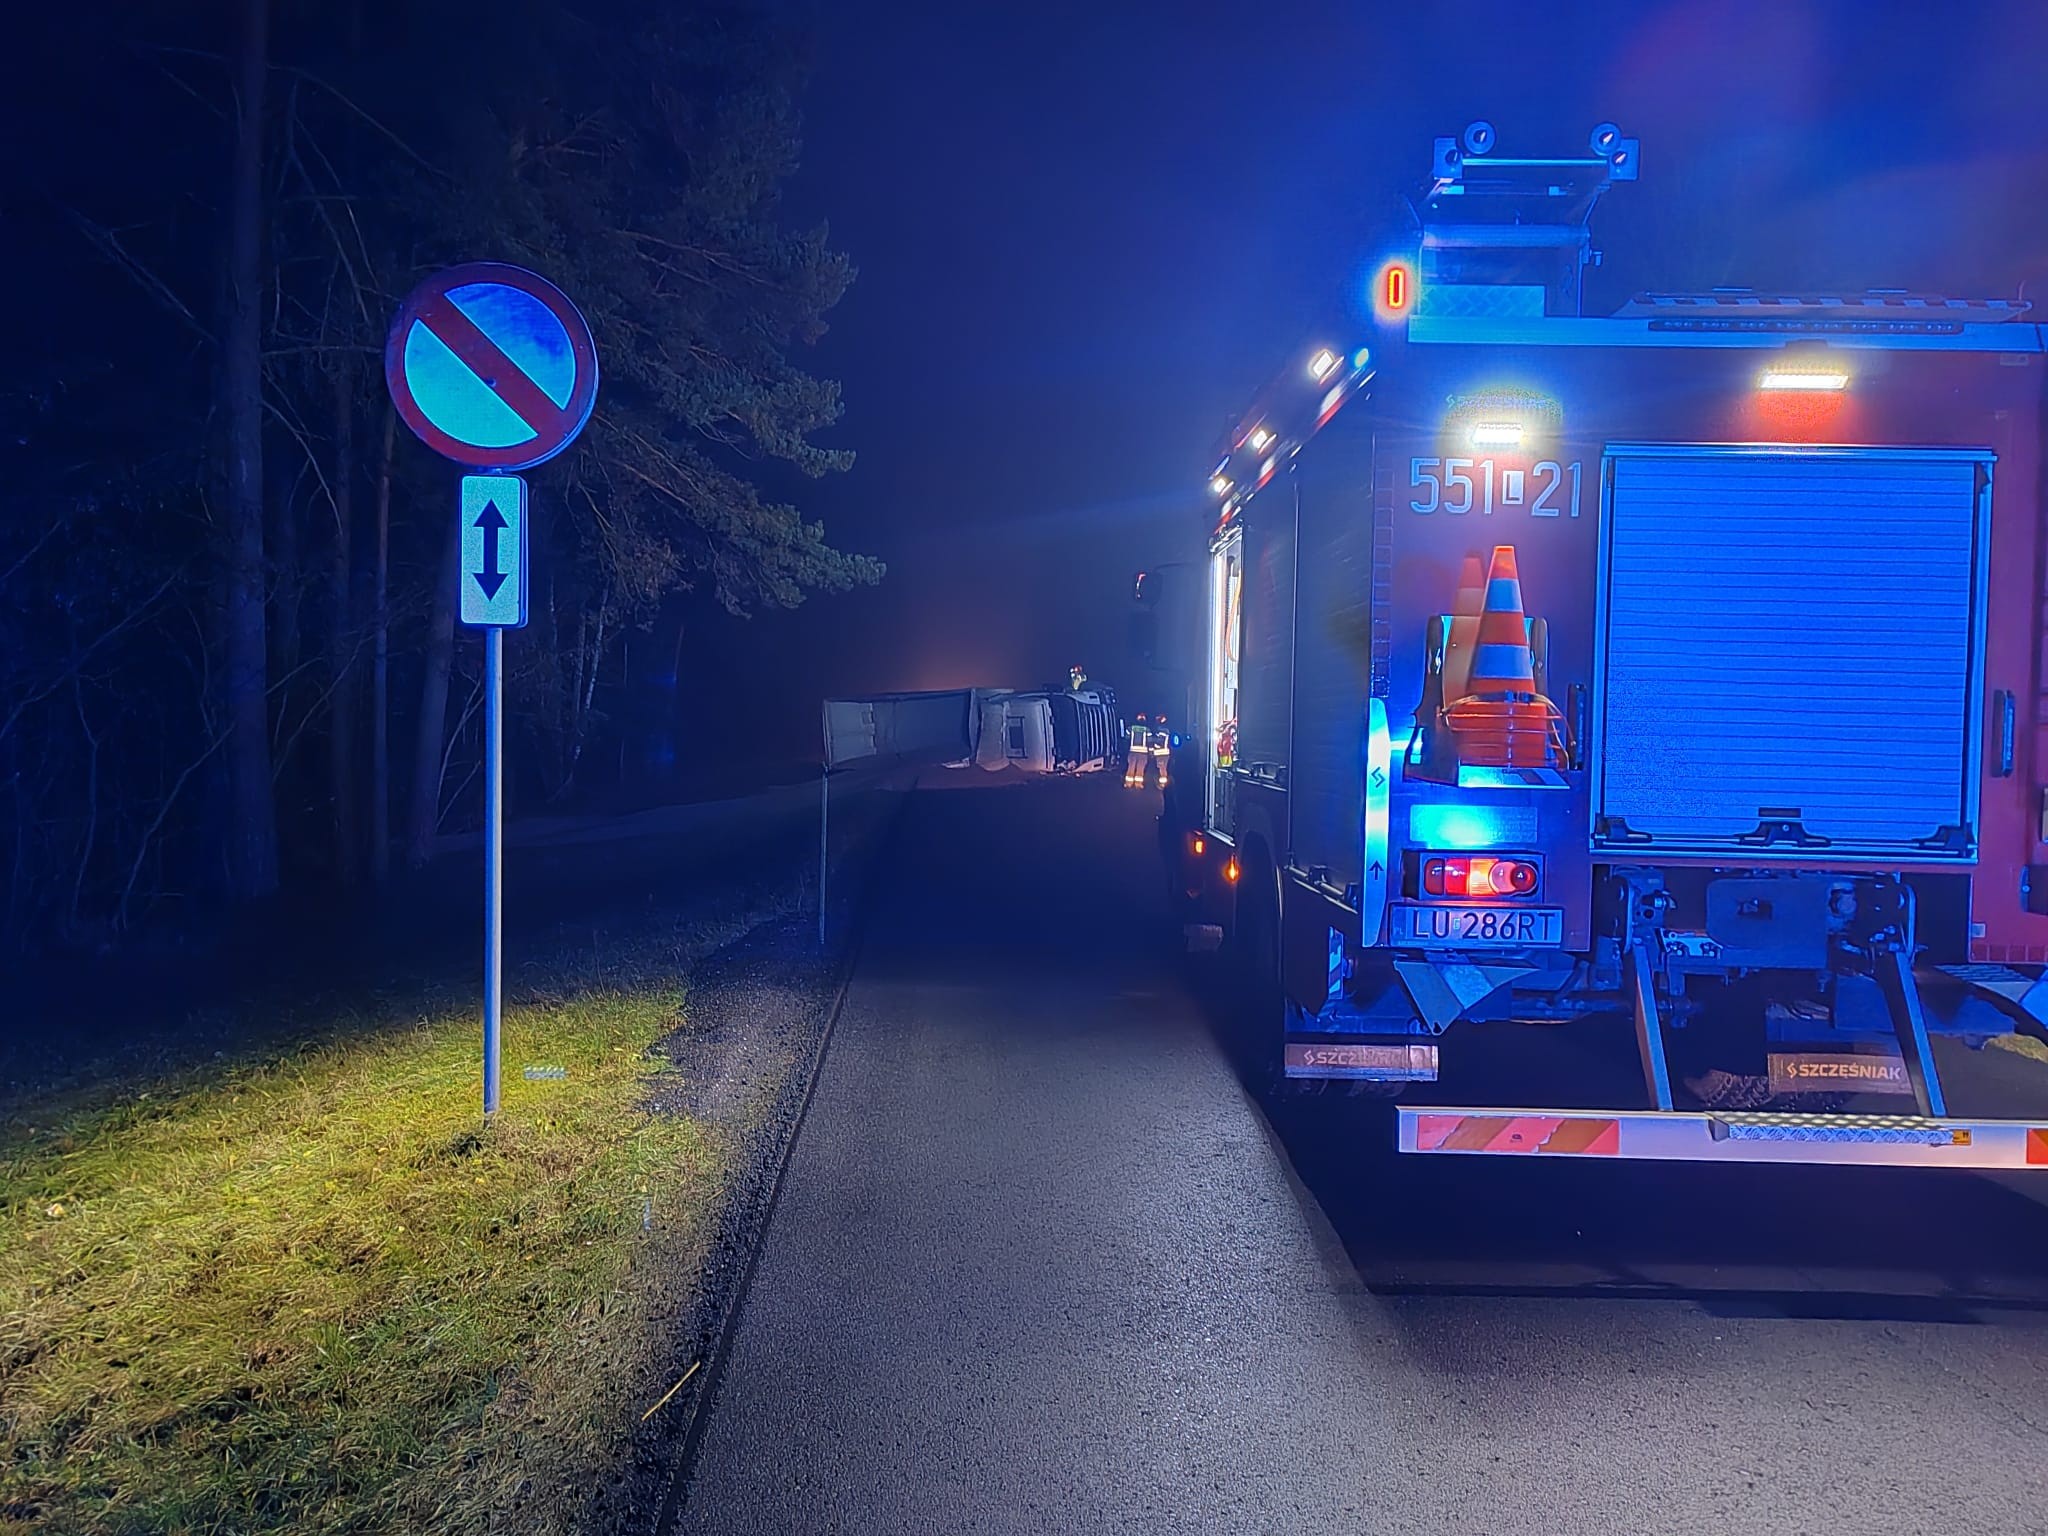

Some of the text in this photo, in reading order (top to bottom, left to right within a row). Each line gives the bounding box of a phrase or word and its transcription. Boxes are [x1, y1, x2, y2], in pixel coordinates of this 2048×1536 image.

[1414, 910, 1555, 941] LU 286RT
[1799, 1062, 1901, 1080] SZCZĘŚNIAK
